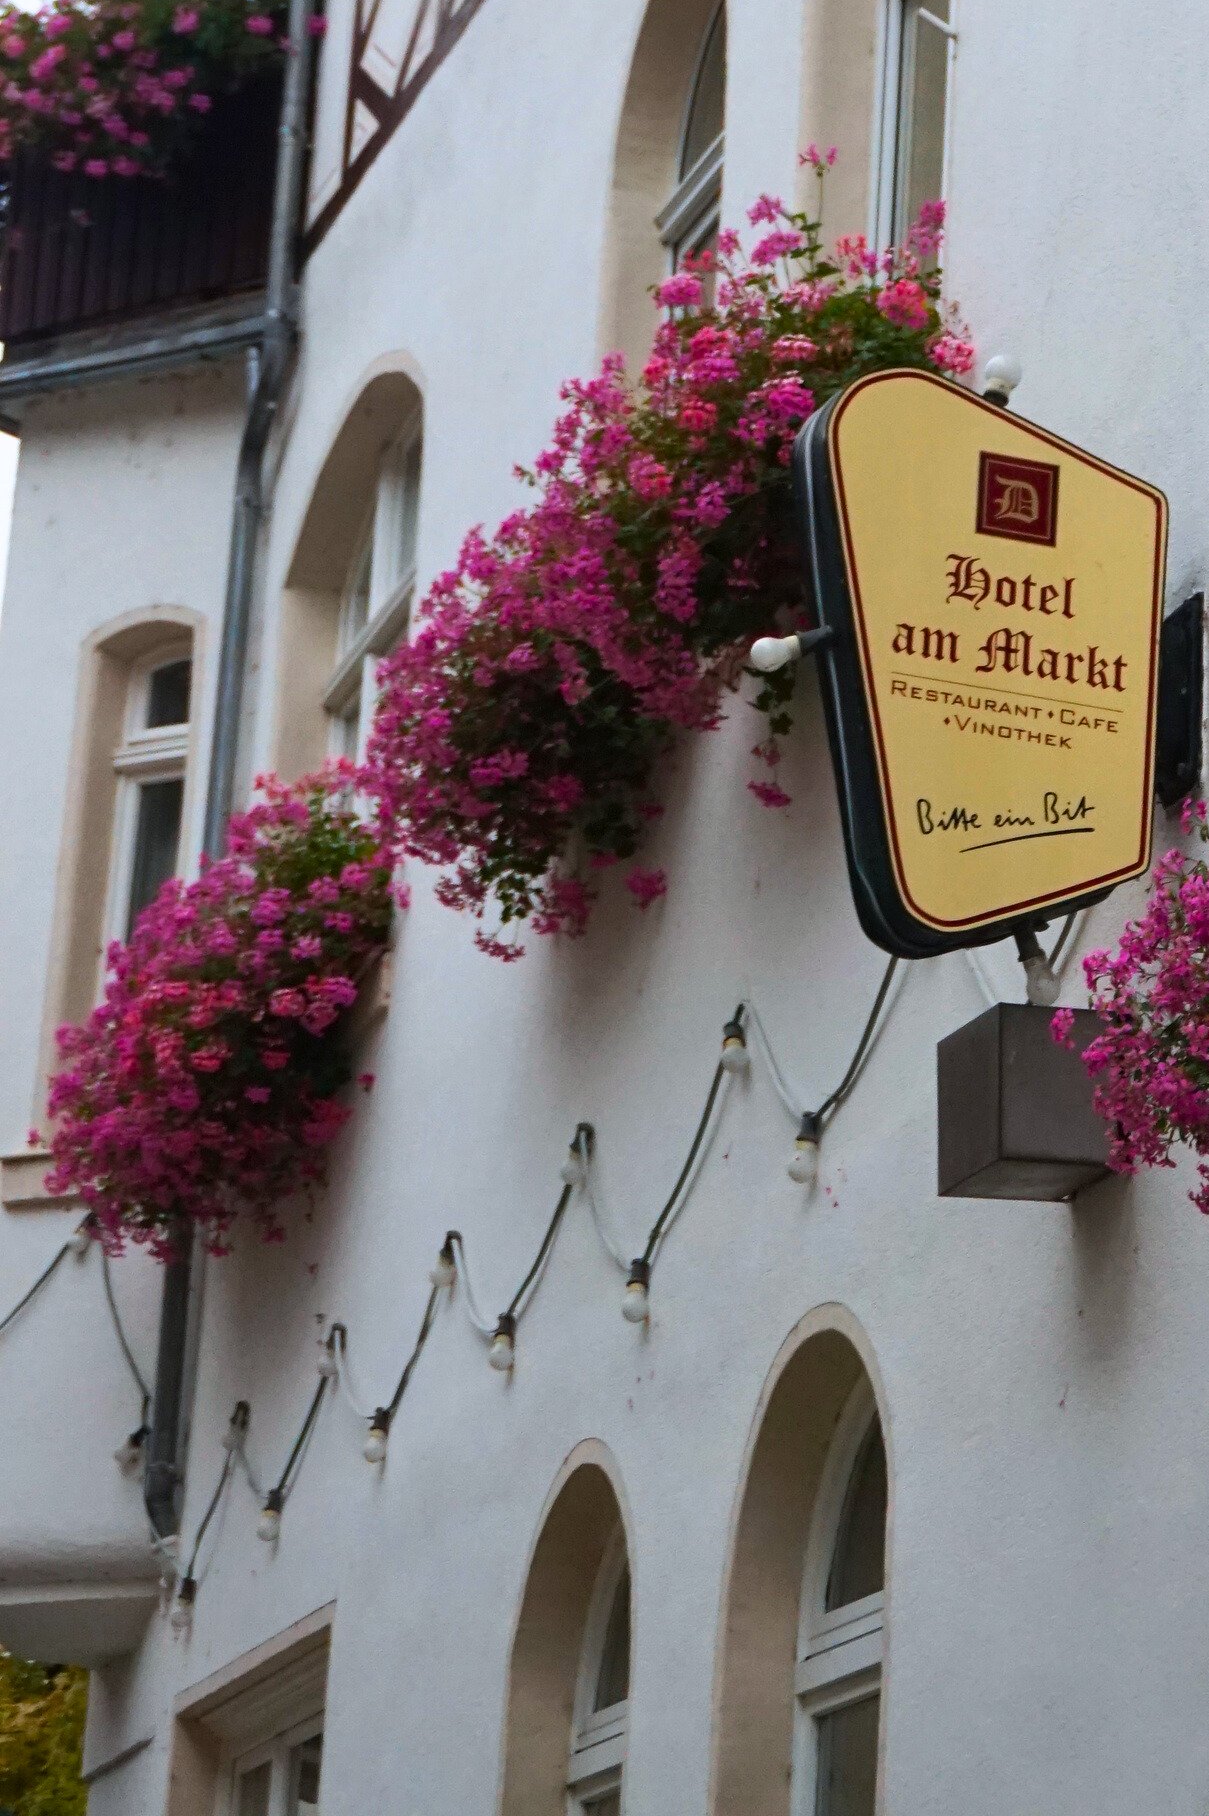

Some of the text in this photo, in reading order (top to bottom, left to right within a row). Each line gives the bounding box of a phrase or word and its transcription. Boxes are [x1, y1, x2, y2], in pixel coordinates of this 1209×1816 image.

[994, 475, 1040, 524] D
[945, 553, 1077, 619] Hotel
[890, 622, 1129, 693] am Markt
[890, 680, 1118, 733] RESTAURANT CAFE
[954, 715, 1073, 749] VINOTHEK
[916, 792, 1096, 835] Bitte ein Bit
